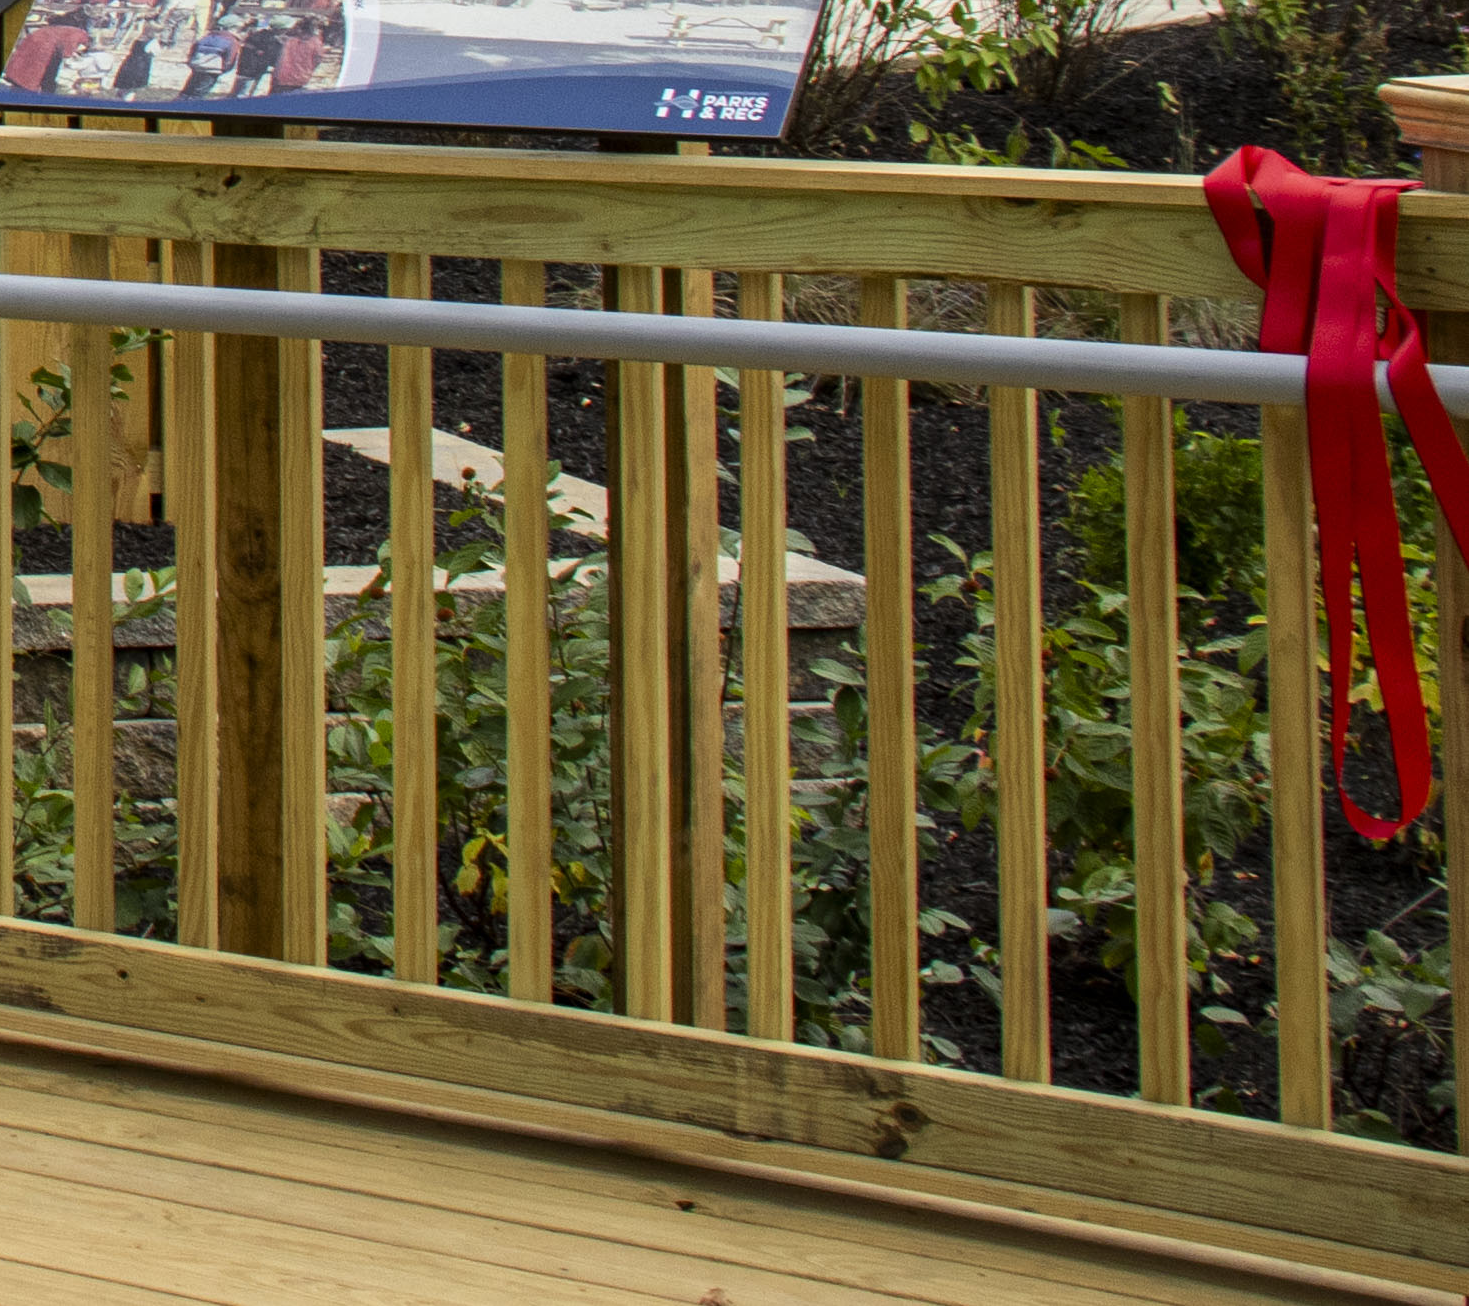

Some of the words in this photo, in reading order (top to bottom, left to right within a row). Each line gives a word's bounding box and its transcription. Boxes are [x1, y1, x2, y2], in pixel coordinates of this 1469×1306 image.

[702, 95, 770, 109] PARKS
[698, 106, 716, 120] &
[719, 107, 765, 122] REC
